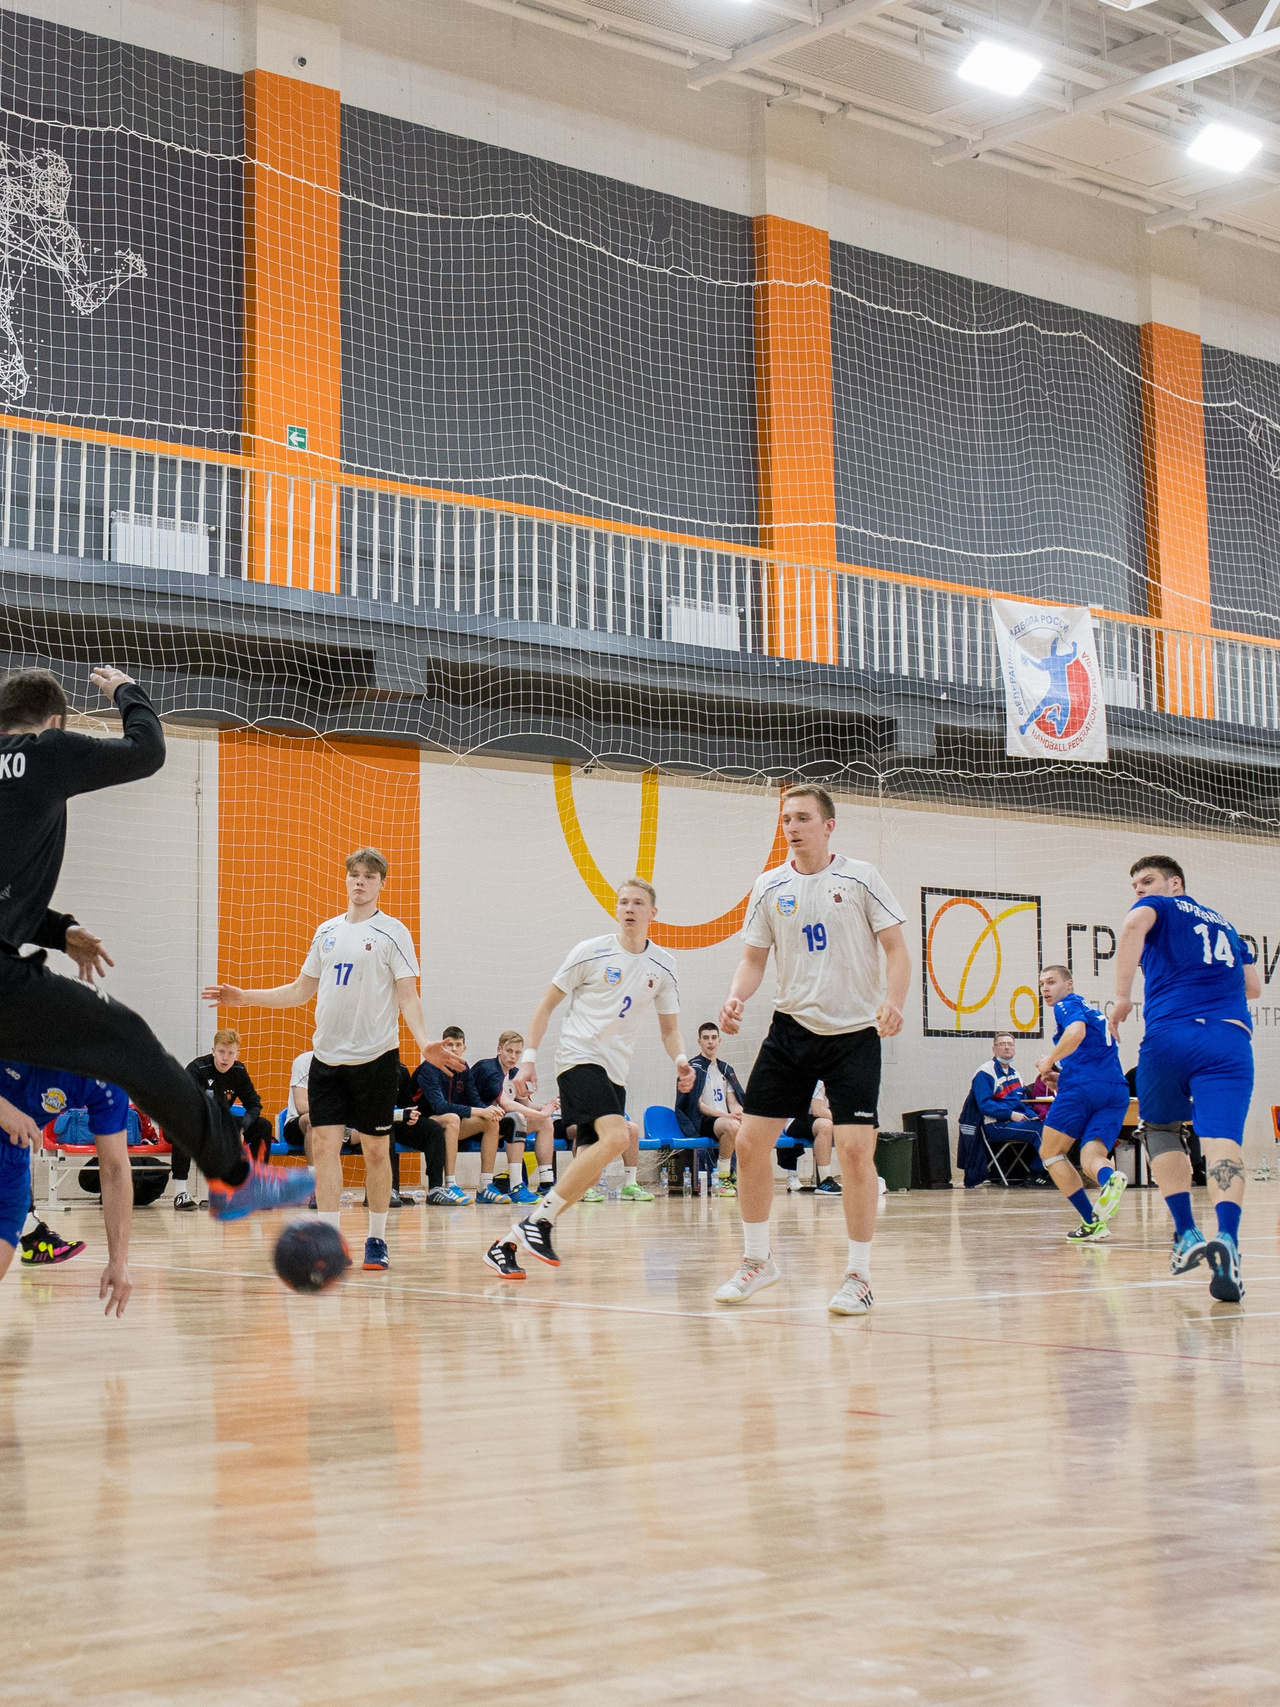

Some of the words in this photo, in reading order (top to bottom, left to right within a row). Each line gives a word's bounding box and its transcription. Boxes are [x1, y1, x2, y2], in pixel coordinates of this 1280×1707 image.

[1041, 615, 1070, 632] РОССИ
[1031, 729, 1067, 752] HANDBALL
[1068, 706, 1097, 750] FEDERATION
[801, 922, 827, 952] 19
[1193, 923, 1235, 968] 14
[333, 962, 354, 986] 17
[618, 996, 632, 1019] 2
